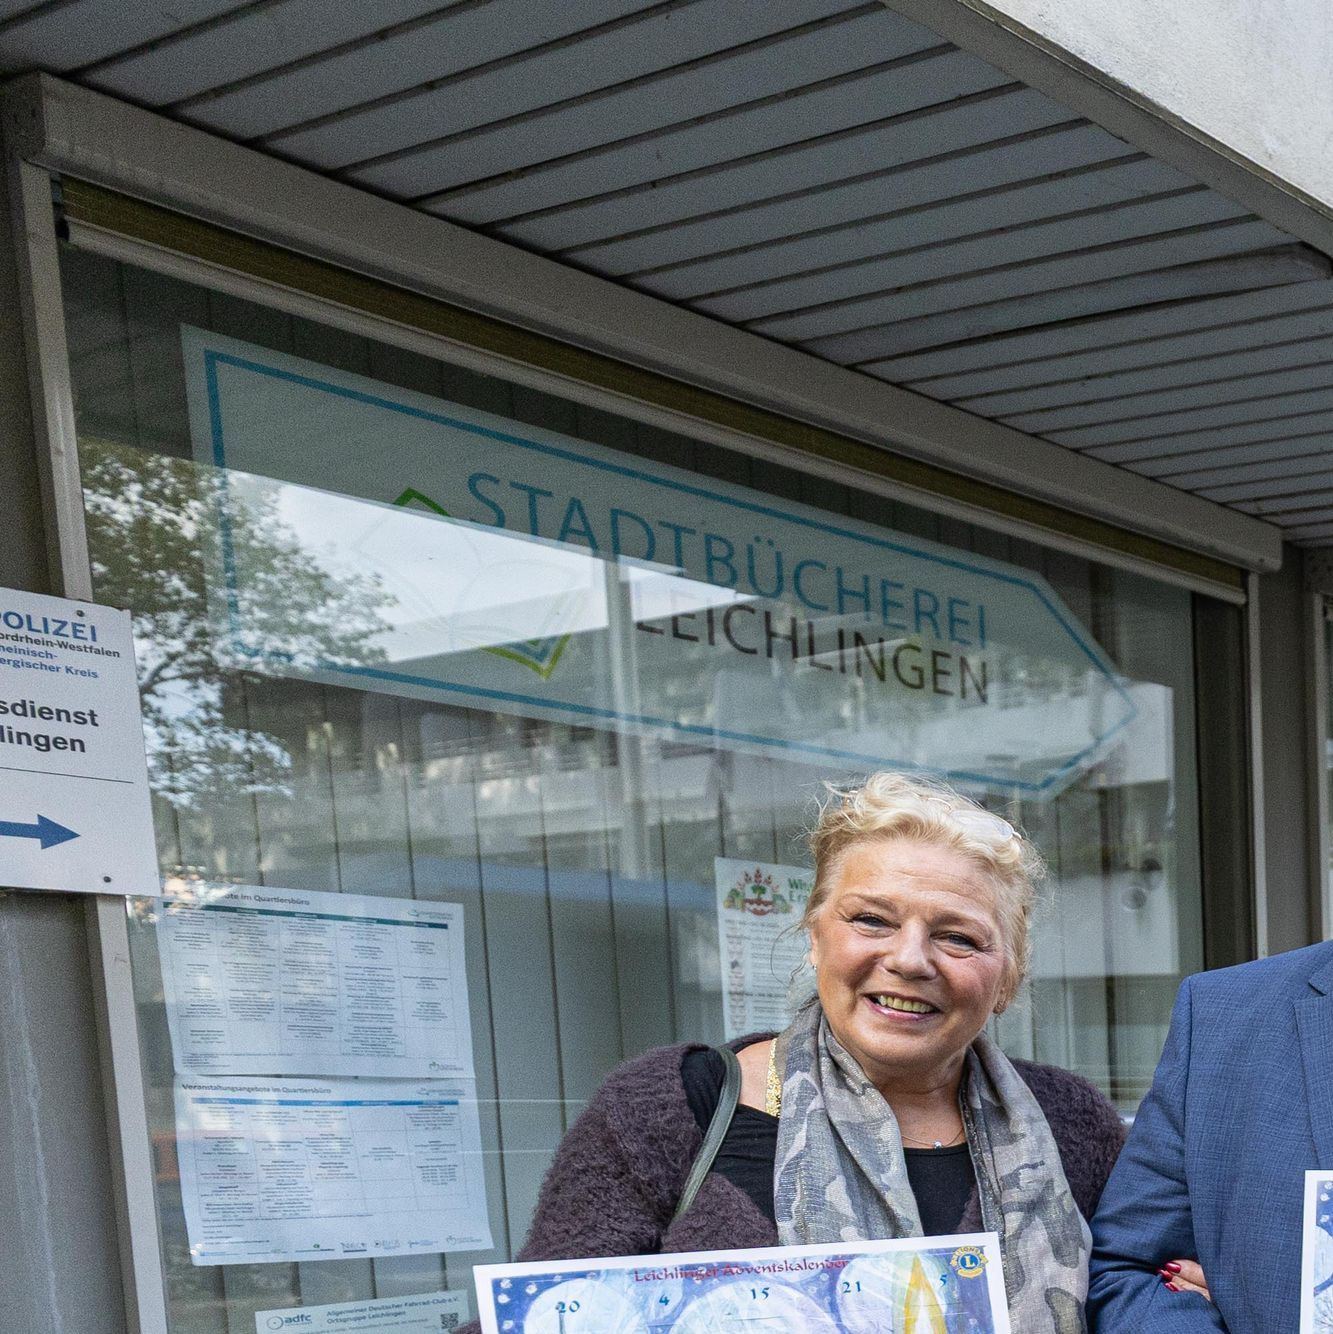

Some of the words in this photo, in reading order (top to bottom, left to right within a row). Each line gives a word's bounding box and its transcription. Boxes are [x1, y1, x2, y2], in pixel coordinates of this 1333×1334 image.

[467, 474, 986, 649] STADTBÜCHEREI
[0, 611, 97, 642] OLIZEI
[65, 665, 99, 679] Kreis
[633, 1265, 720, 1283] Leichlinger
[722, 1257, 850, 1276] Adventskalender
[751, 1287, 771, 1299] 15
[843, 1281, 861, 1292] 21
[557, 1300, 581, 1313] 20
[284, 1313, 312, 1323] adfc
